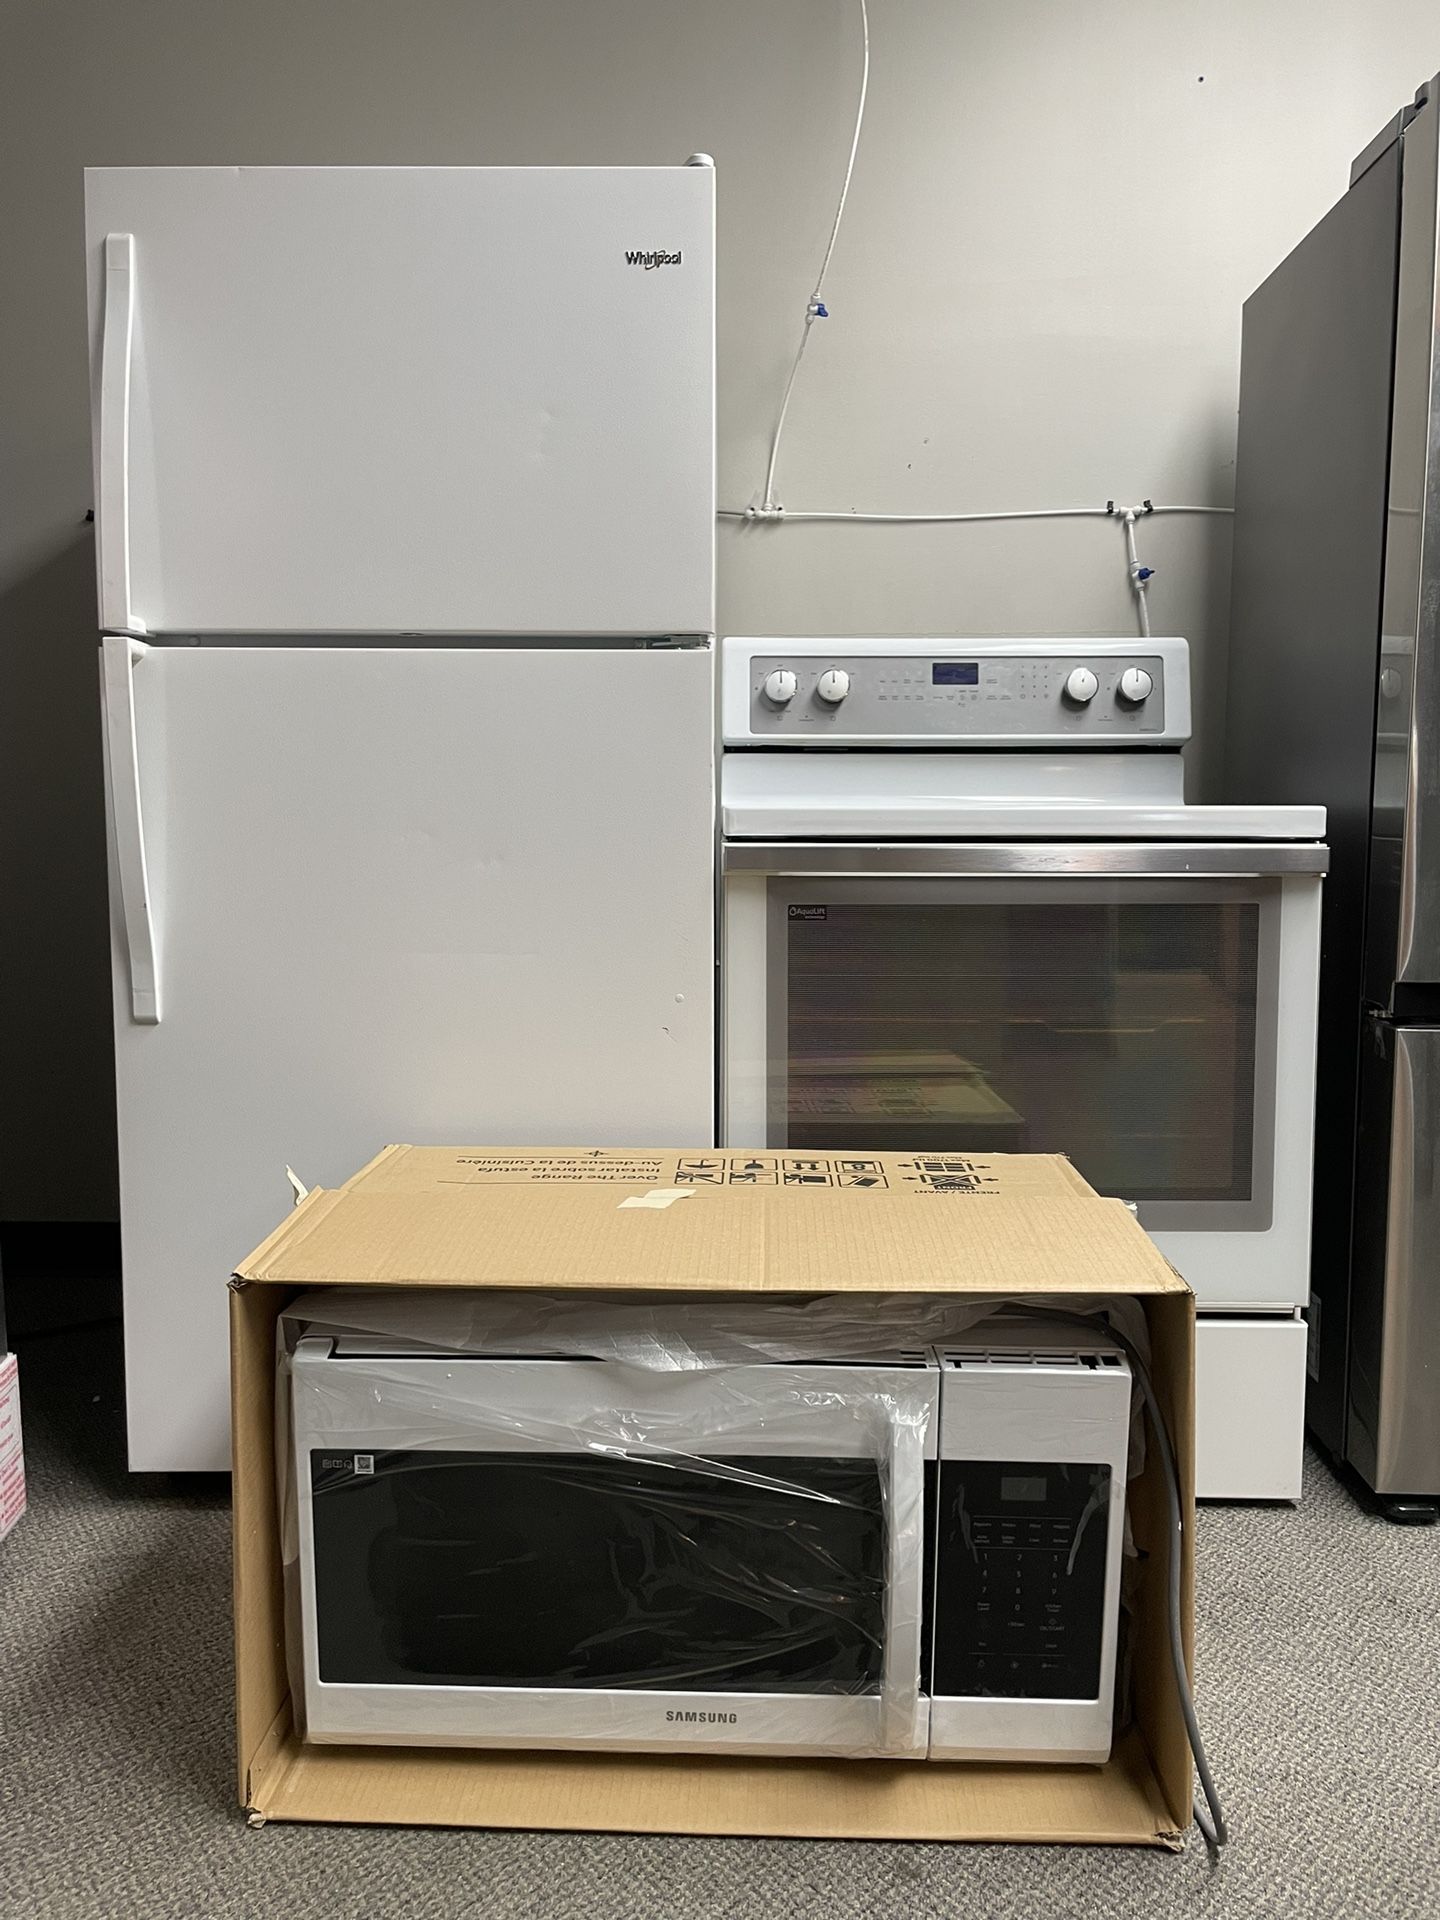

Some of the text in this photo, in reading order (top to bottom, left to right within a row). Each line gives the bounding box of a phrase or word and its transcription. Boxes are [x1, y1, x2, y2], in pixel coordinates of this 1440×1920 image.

[625, 249, 682, 271] Whirlpool
[796, 907, 826, 915] AquaLift
[665, 1710, 738, 1724] SAMSUNG
